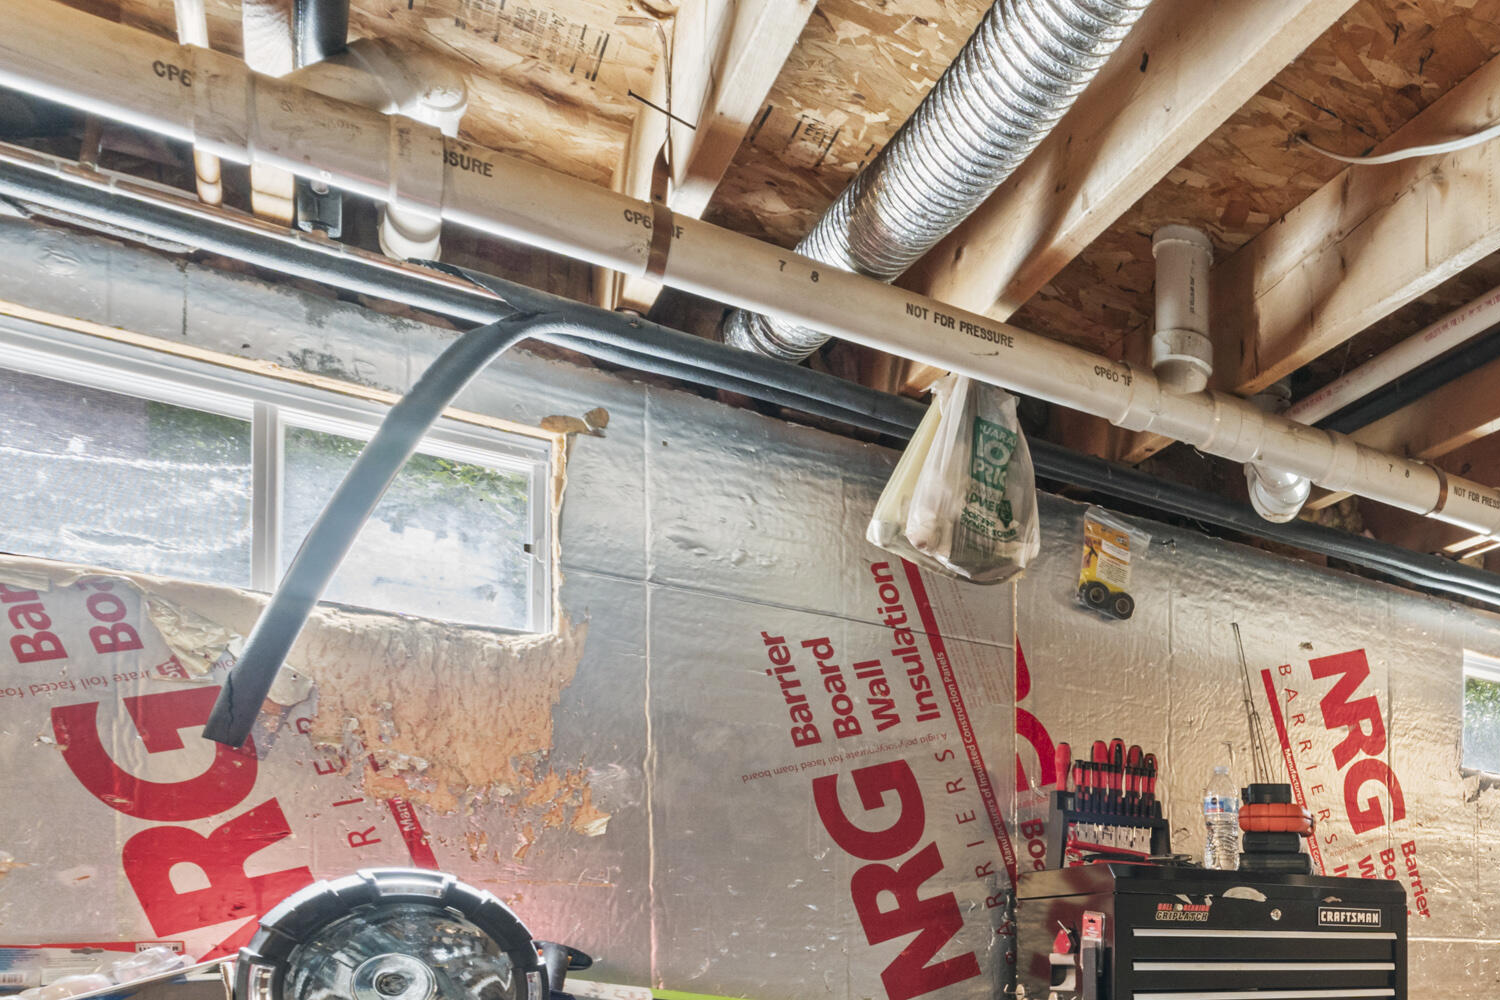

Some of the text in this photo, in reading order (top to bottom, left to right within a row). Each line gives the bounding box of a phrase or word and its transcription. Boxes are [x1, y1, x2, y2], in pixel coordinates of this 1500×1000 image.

[153, 60, 193, 87] CP6
[778, 259, 820, 283] 7 8
[906, 302, 1014, 348] NOT FOR PRESSURE
[1454, 486, 1466, 497] NOT
[1468, 490, 1480, 503] FOR
[0, 583, 68, 664] Bar
[870, 561, 941, 722] Insulation
[29, 679, 76, 695] faced
[80, 673, 108, 687] foil
[761, 631, 822, 748] Barrier
[801, 637, 863, 739] Board
[937, 651, 951, 684] Panels
[853, 659, 901, 733] Wall
[950, 683, 973, 746] Construction
[802, 759, 827, 770] faced
[1279, 664, 1338, 845] BARRIERS
[1308, 648, 1406, 835] NRG
[742, 771, 772, 784] board
[773, 765, 799, 779] foam
[967, 744, 990, 790] Insulated
[51, 685, 316, 963] RG
[1401, 840, 1431, 918] Barrier
[1320, 911, 1379, 924] CRAFTSMAN
